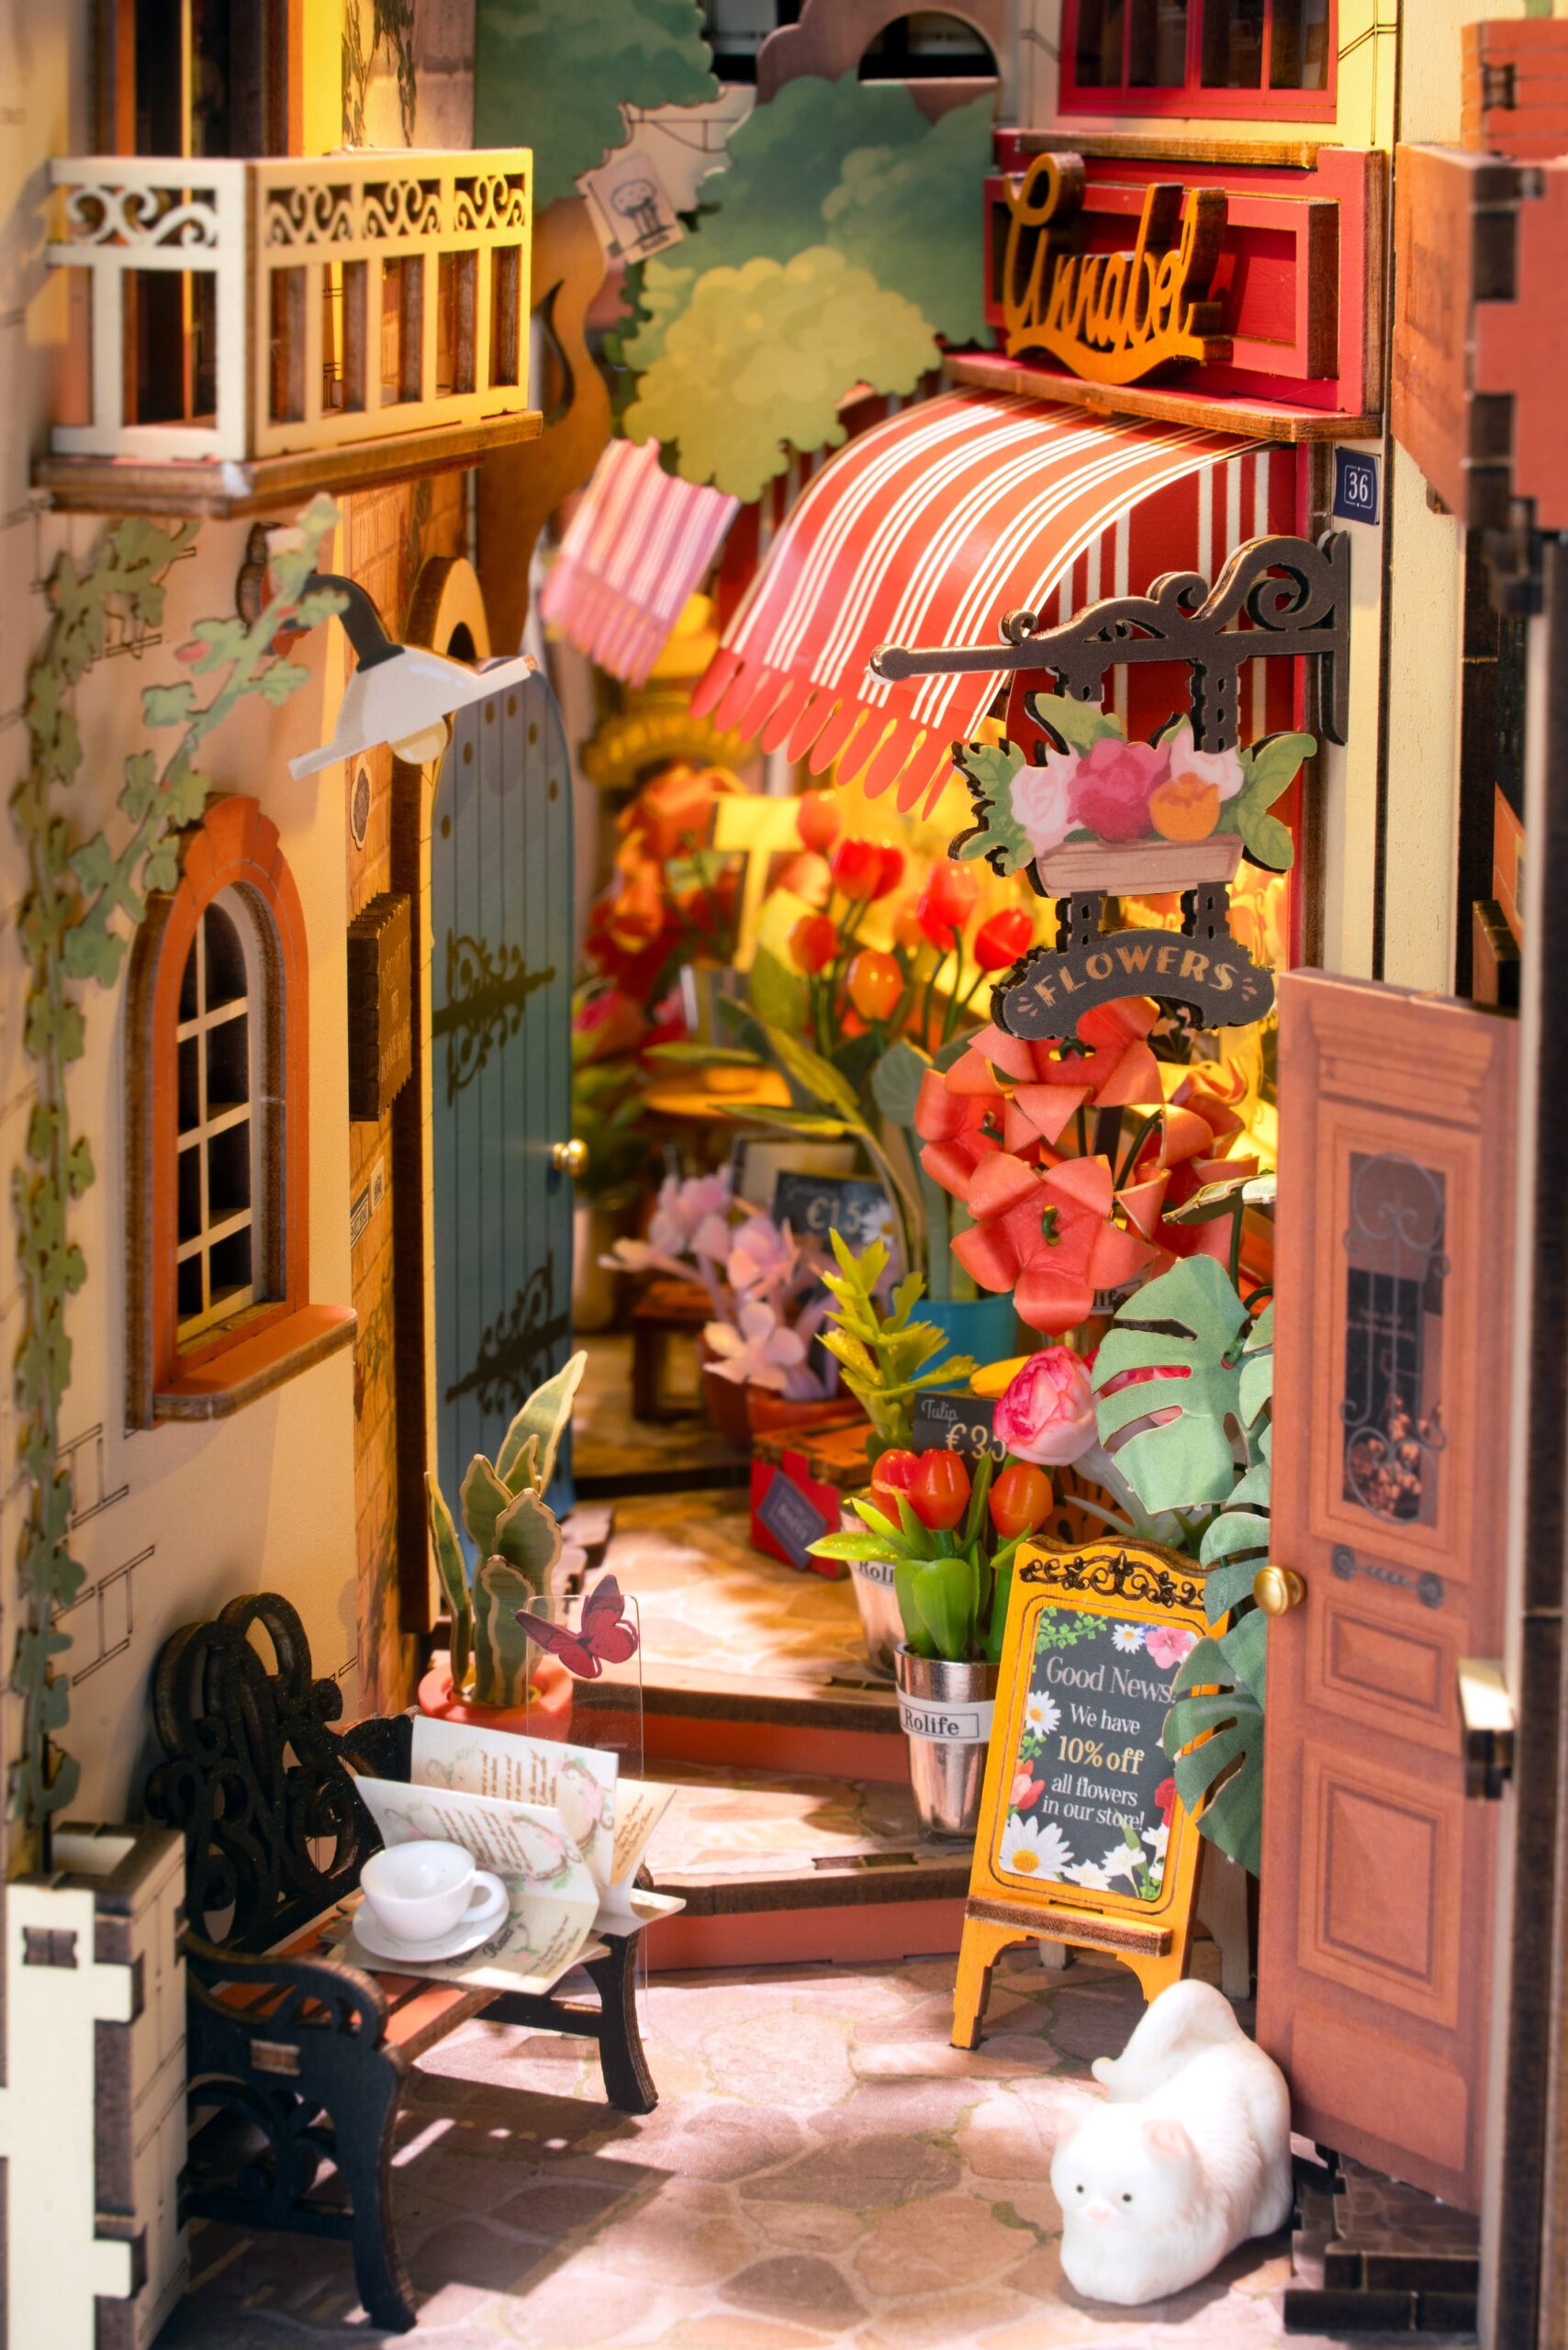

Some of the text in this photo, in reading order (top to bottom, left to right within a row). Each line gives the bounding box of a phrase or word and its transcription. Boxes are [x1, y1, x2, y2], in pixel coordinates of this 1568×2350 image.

[1003, 152, 1216, 358] Annabel
[1348, 471, 1369, 502] 36
[1034, 945, 1238, 1008] FLOWERS
[921, 1399, 959, 1428] Tulip
[859, 1560, 894, 1583] Roli
[1046, 1655, 1176, 1705] Good News
[904, 1707, 959, 1736] Rolife
[1070, 1703, 1141, 1735] We have
[1057, 1735, 1146, 1775] 10% off
[1051, 1774, 1138, 1807] all flowers
[1041, 1796, 1146, 1831] in our store!
